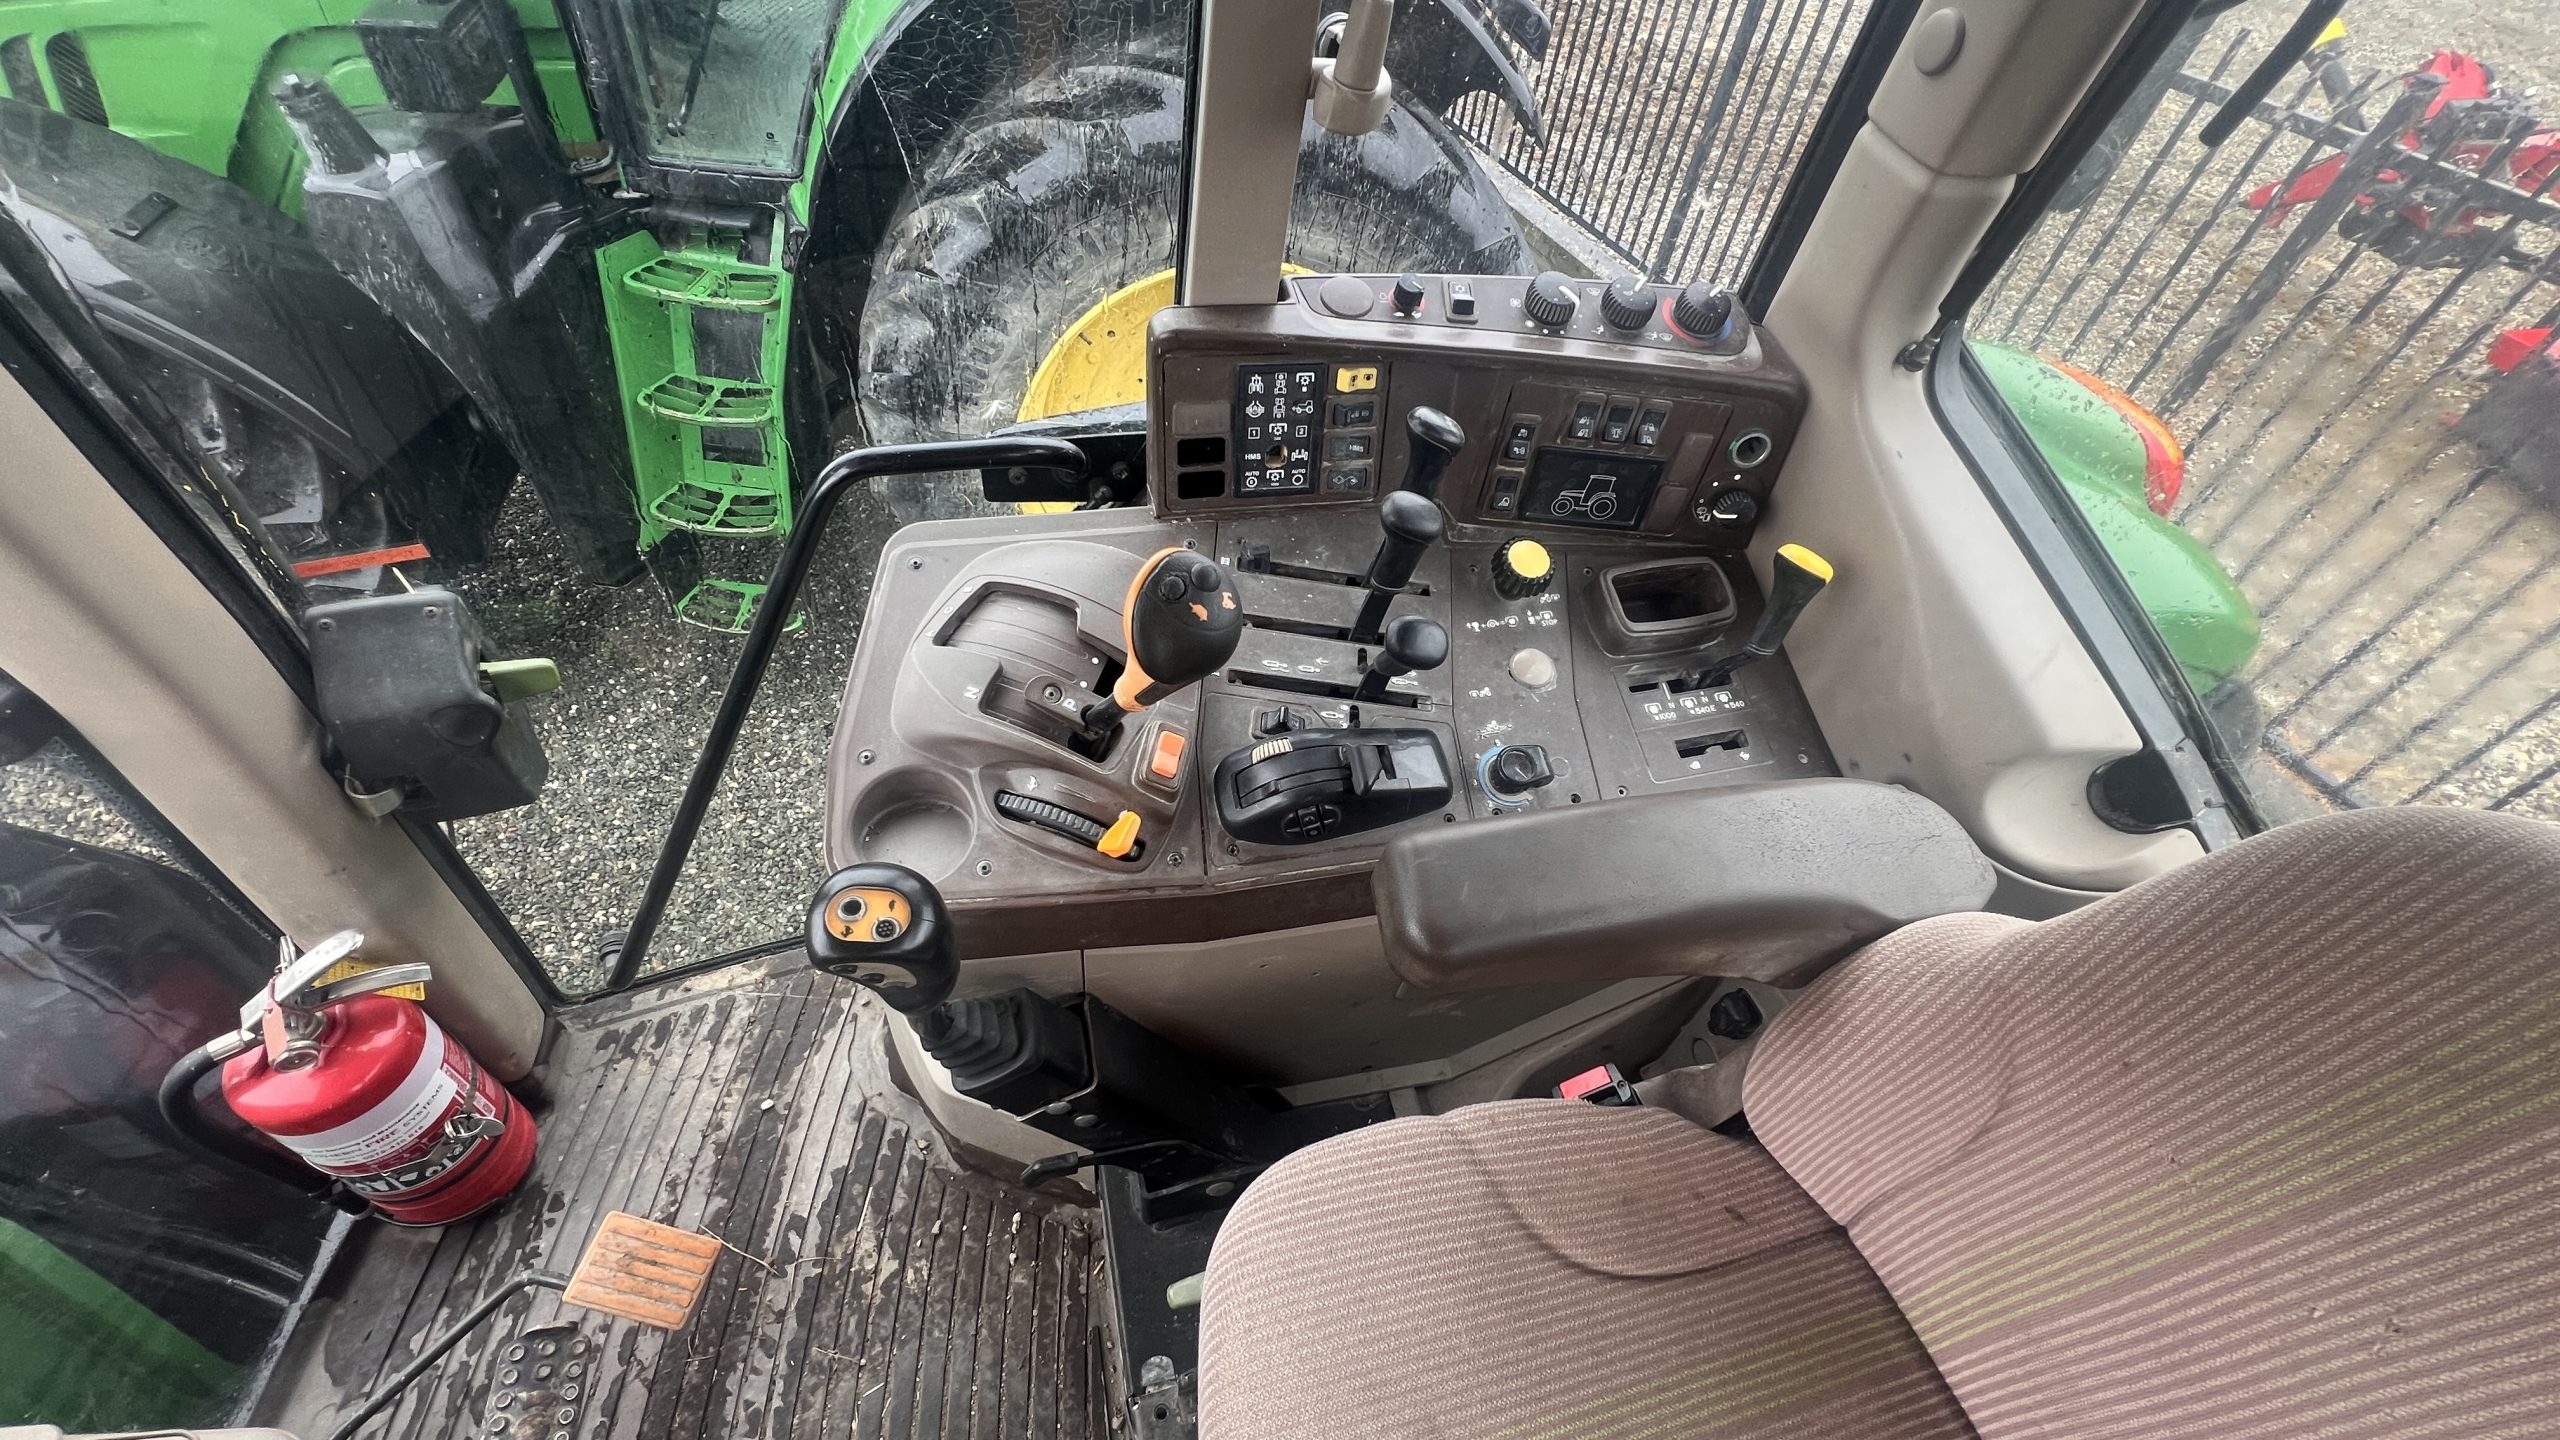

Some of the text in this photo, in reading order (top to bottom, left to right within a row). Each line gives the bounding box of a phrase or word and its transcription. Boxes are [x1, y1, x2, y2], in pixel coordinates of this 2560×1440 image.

[1349, 444, 1364, 453] HMS
[1541, 618, 1558, 627] STOP
[963, 685, 980, 700] N
[1701, 695, 1709, 703] N
[1062, 698, 1077, 712] P
[1668, 701, 1676, 709] N
[1729, 700, 1745, 709] 540
[1659, 711, 1677, 720] 1000
[402, 1083, 444, 1129] SYSTEMS
